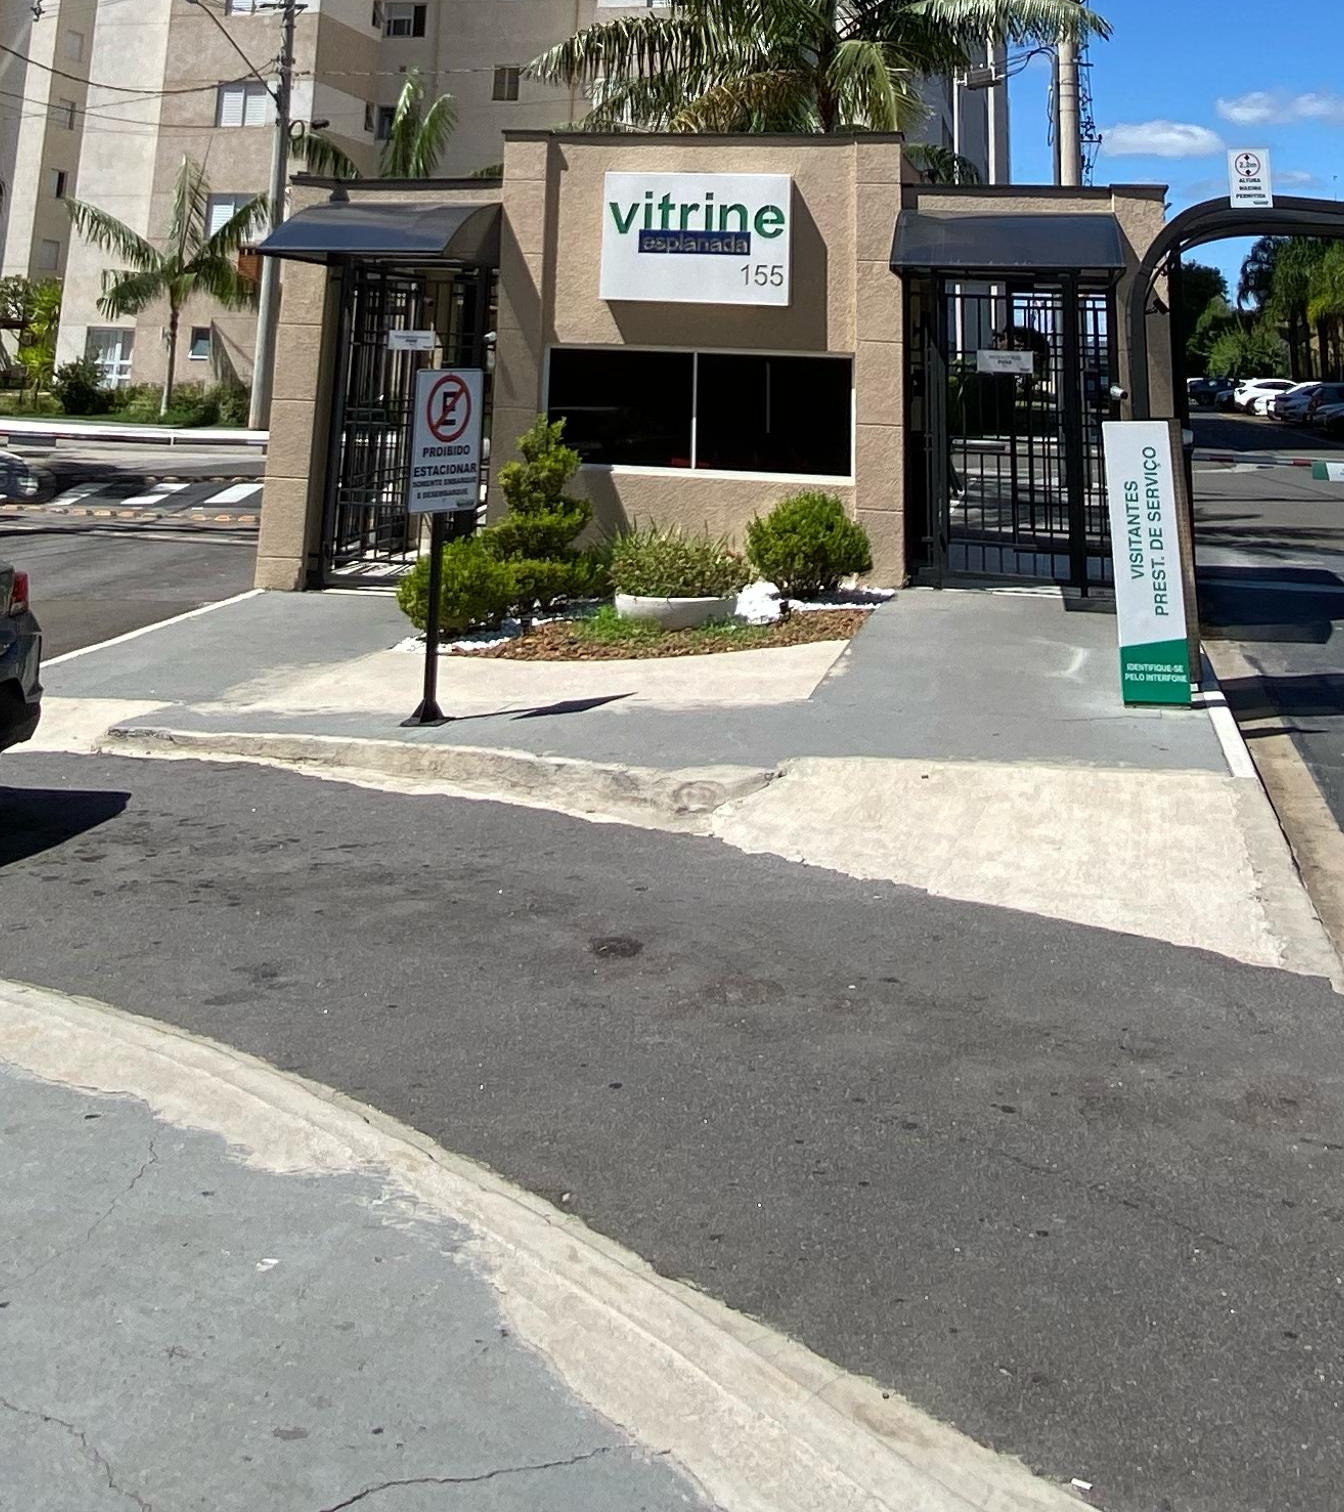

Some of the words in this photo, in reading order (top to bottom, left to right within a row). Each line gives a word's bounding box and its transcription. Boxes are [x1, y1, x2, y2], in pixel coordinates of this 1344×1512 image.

[609, 191, 785, 239] vitrine
[642, 233, 749, 254] esplanada
[740, 264, 784, 286] 155
[422, 445, 471, 458] PROIBIDO
[414, 463, 477, 477] ESTACIONAR
[1142, 446, 1162, 519] SERVIÇO
[1124, 480, 1145, 579] VISITANTES
[1150, 526, 1164, 552] DE
[1151, 556, 1169, 616] PREST.
[1124, 673, 1145, 681] PELO
